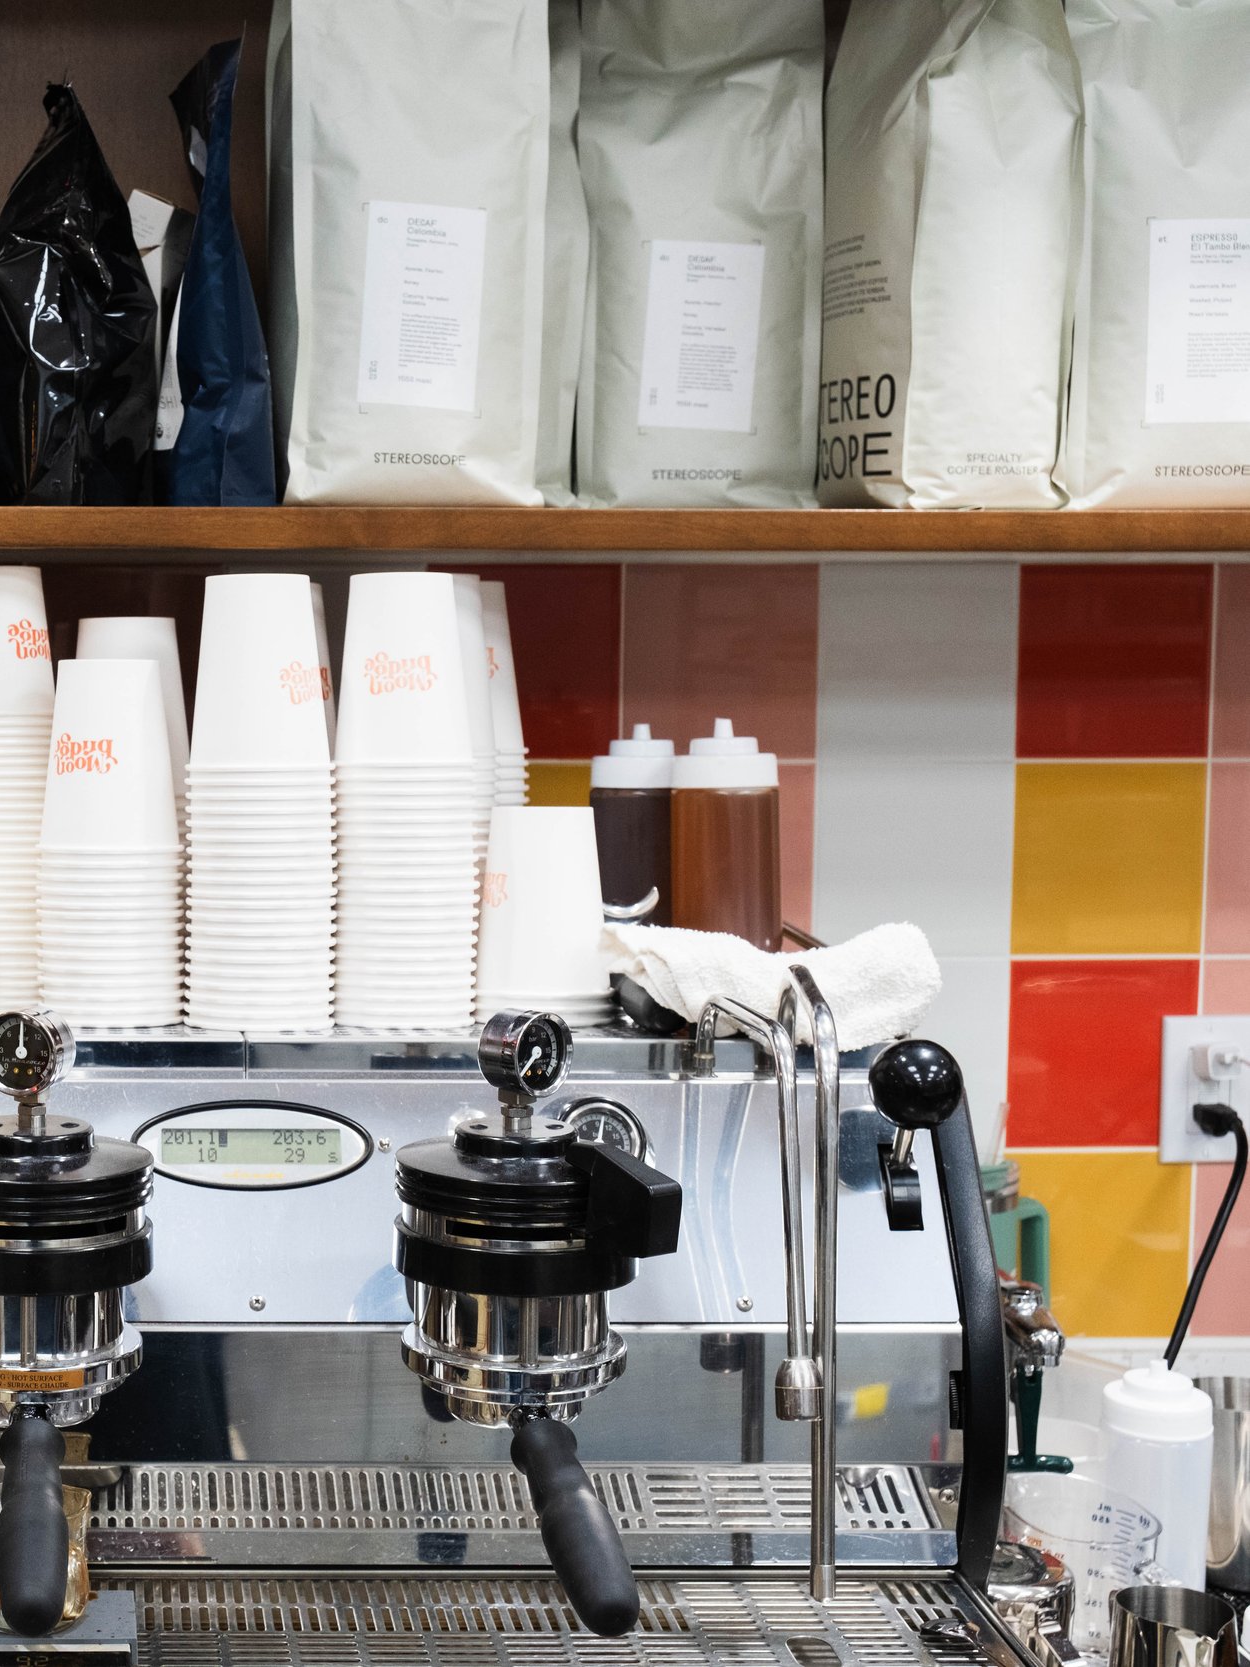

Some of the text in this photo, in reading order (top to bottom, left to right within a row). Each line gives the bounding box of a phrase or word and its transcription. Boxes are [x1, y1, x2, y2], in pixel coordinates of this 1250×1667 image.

[407, 217, 437, 226] DECAF
[406, 226, 446, 238] Colombia
[1190, 233, 1238, 242] ESPRESSO
[1204, 243, 1231, 251] Tambo
[1233, 243, 1250, 251] Blen
[821, 374, 896, 424] TEREO
[374, 452, 466, 466] STEREOSCOPE
[821, 432, 892, 482] COPE
[966, 453, 1022, 462] SPECIALTY
[652, 469, 742, 480] STEREOSCOPE
[946, 466, 992, 476] COFFEE
[1154, 464, 1250, 478] STEREOSCOPE
[8, 619, 48, 645] ridge
[364, 651, 431, 678] bridge
[364, 672, 438, 696] Moon
[54, 754, 118, 776] Moon
[164, 1130, 327, 1146] 201.1 203.6
[198, 1148, 218, 1162] 10
[284, 1149, 305, 1163] 29
